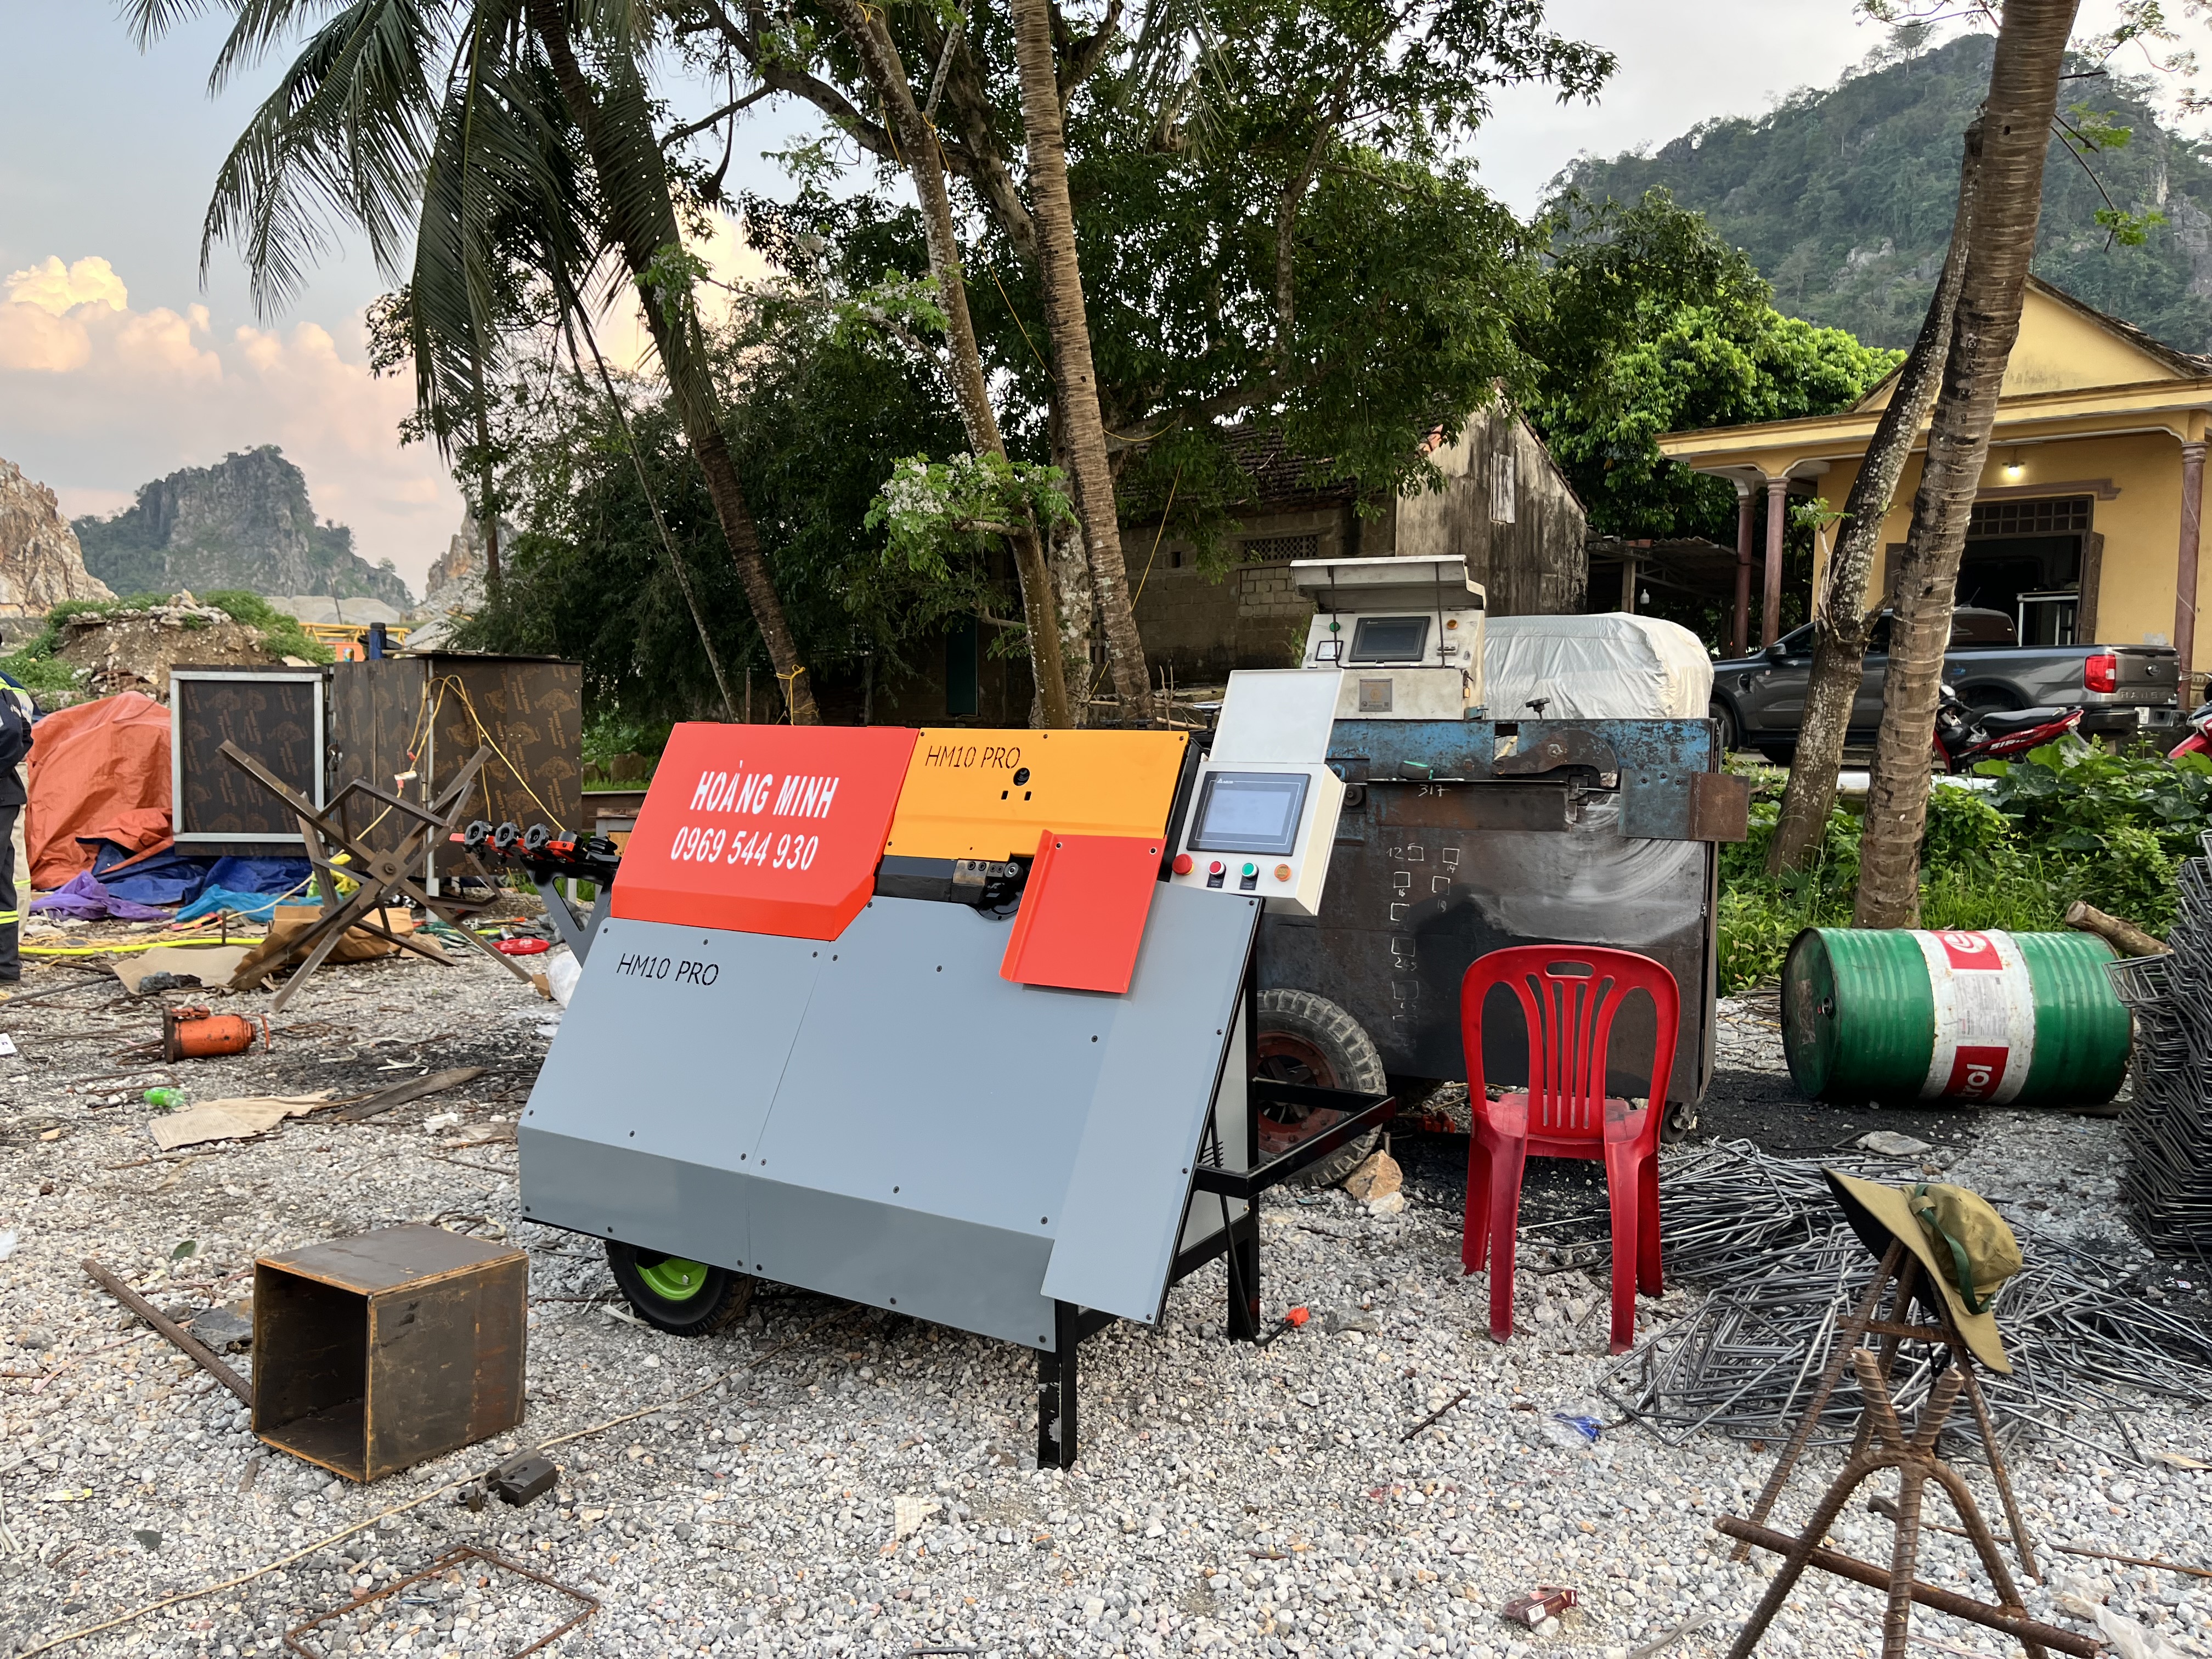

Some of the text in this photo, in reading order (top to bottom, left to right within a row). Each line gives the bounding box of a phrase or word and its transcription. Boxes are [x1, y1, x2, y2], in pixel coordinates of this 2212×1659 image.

[522, 695, 531, 714] LONG
[558, 730, 567, 749] LONG
[925, 746, 1020, 769] HM10 PRO
[690, 760, 839, 818] HOÀNG MINH
[1418, 784, 1451, 797] 317
[557, 797, 567, 816] LONG
[670, 826, 819, 871] 0969 544 930
[1386, 847, 1404, 859] 12
[1447, 865, 1455, 873] 14
[1398, 888, 1406, 897] 16
[616, 953, 719, 985] HM10 PRO
